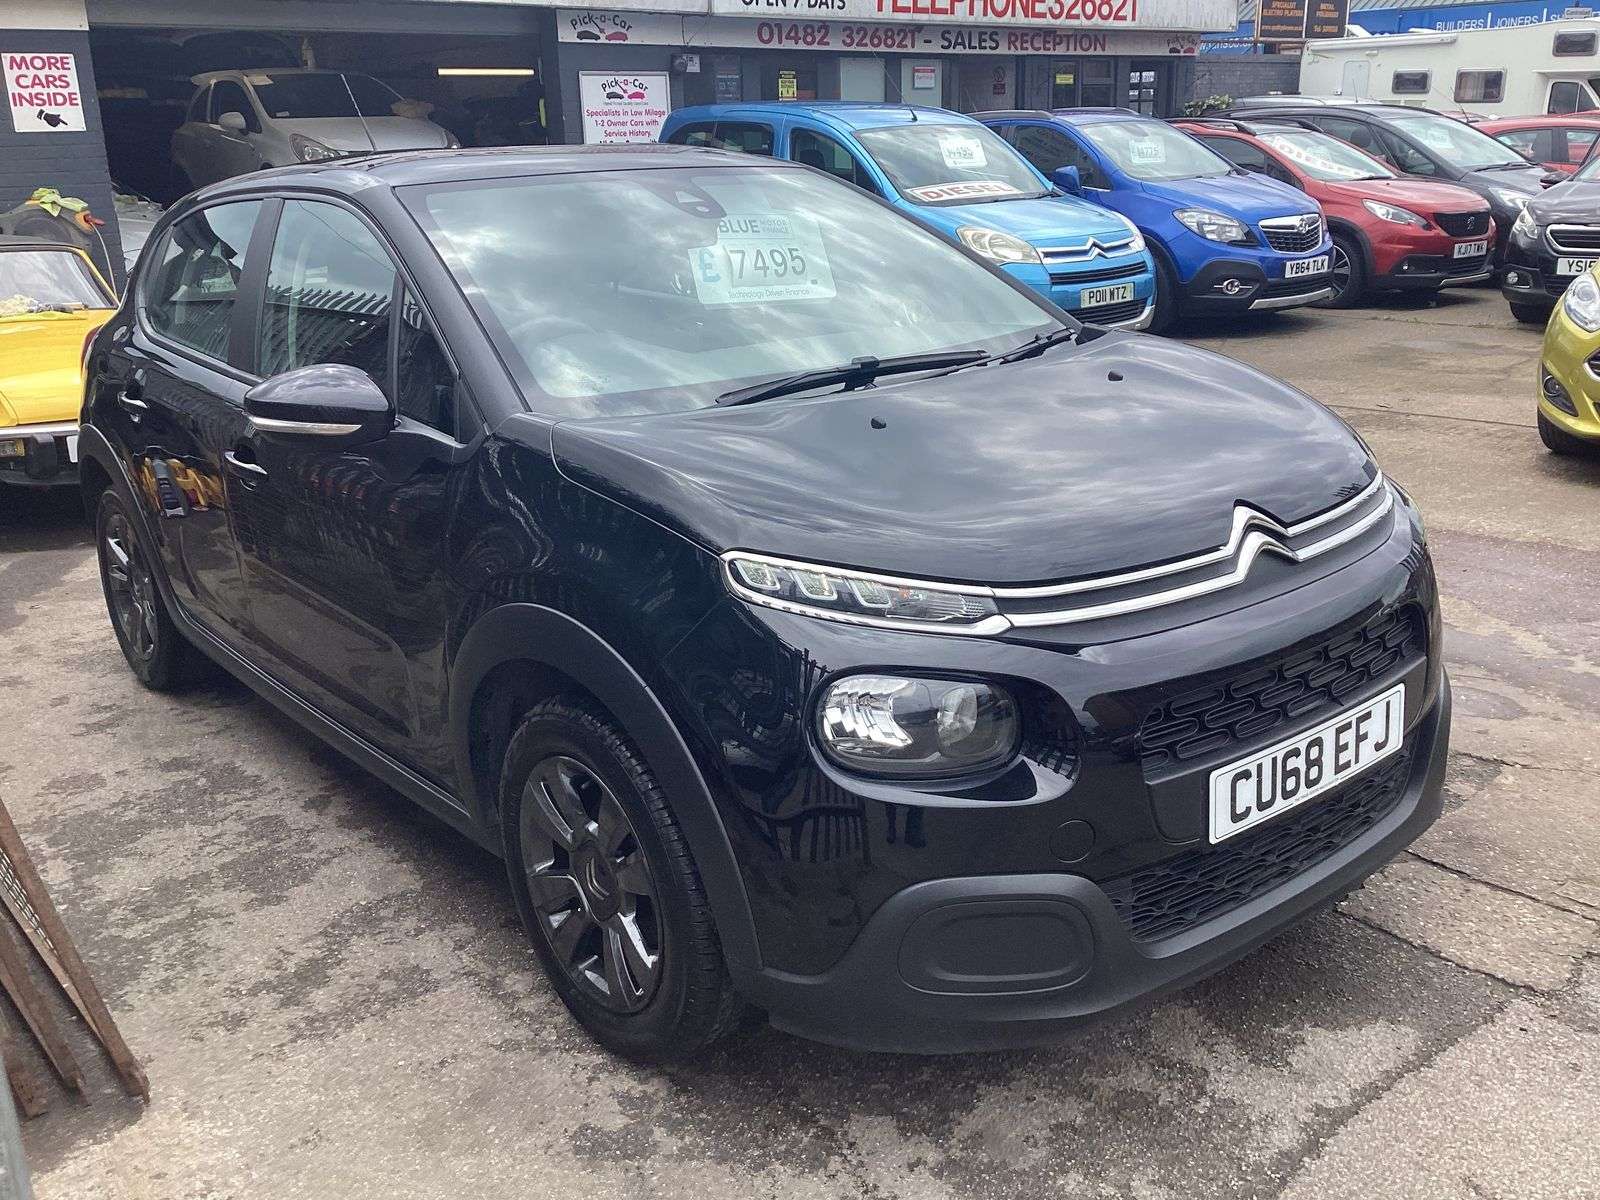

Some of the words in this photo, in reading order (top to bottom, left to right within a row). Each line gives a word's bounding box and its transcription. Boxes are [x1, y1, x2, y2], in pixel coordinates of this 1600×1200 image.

[570, 12, 632, 31] Pick-a-Car
[1436, 19, 1485, 31] BUILDERS
[1494, 15, 1538, 28] JOINERS
[757, 21, 831, 46] 01482
[841, 25, 917, 49] 326821
[940, 30, 1000, 50] SALES
[1007, 31, 1107, 52] RECEPTION
[9, 55, 71, 70] MORE
[15, 74, 70, 89] CARS
[601, 77, 649, 92] Pick-a-Car
[11, 92, 79, 107] INSIDE
[586, 109, 621, 118] Specialists
[645, 109, 666, 117] Milage
[604, 130, 627, 138] Service
[921, 184, 1013, 200] DIESEL
[719, 219, 760, 234] BLUE
[1289, 261, 1310, 275] YB64
[1311, 257, 1327, 271] TLK
[1088, 289, 1107, 304] PO11
[1109, 286, 1127, 301] WTZ
[1230, 735, 1324, 824] CU68
[1334, 699, 1391, 776] EFJ
